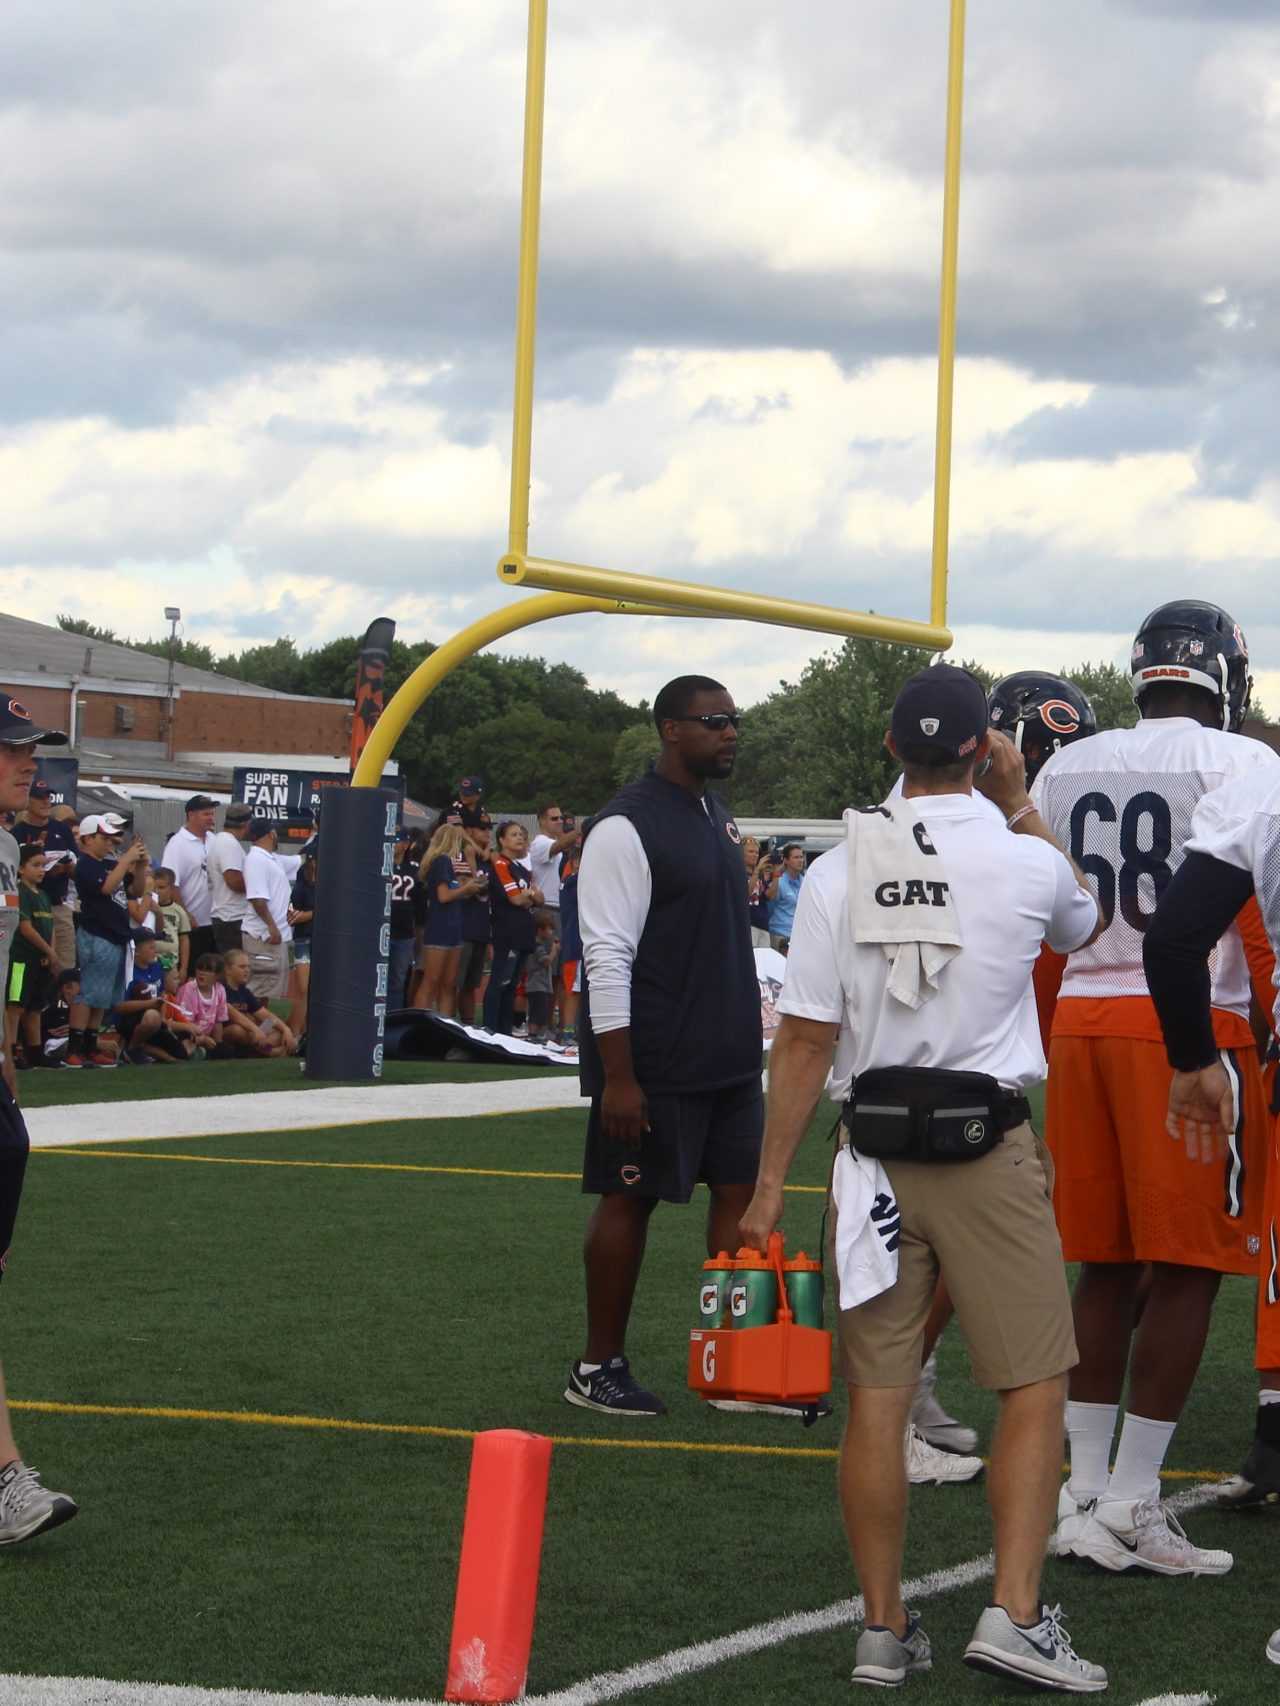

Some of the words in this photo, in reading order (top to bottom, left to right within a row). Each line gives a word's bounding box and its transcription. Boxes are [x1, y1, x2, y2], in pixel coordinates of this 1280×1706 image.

[245, 773, 289, 786] SUPER
[243, 786, 289, 806] FAN
[250, 806, 289, 820] ONE
[1071, 791, 1174, 934] 68
[391, 874, 415, 901] 22
[874, 879, 950, 908] GAT
